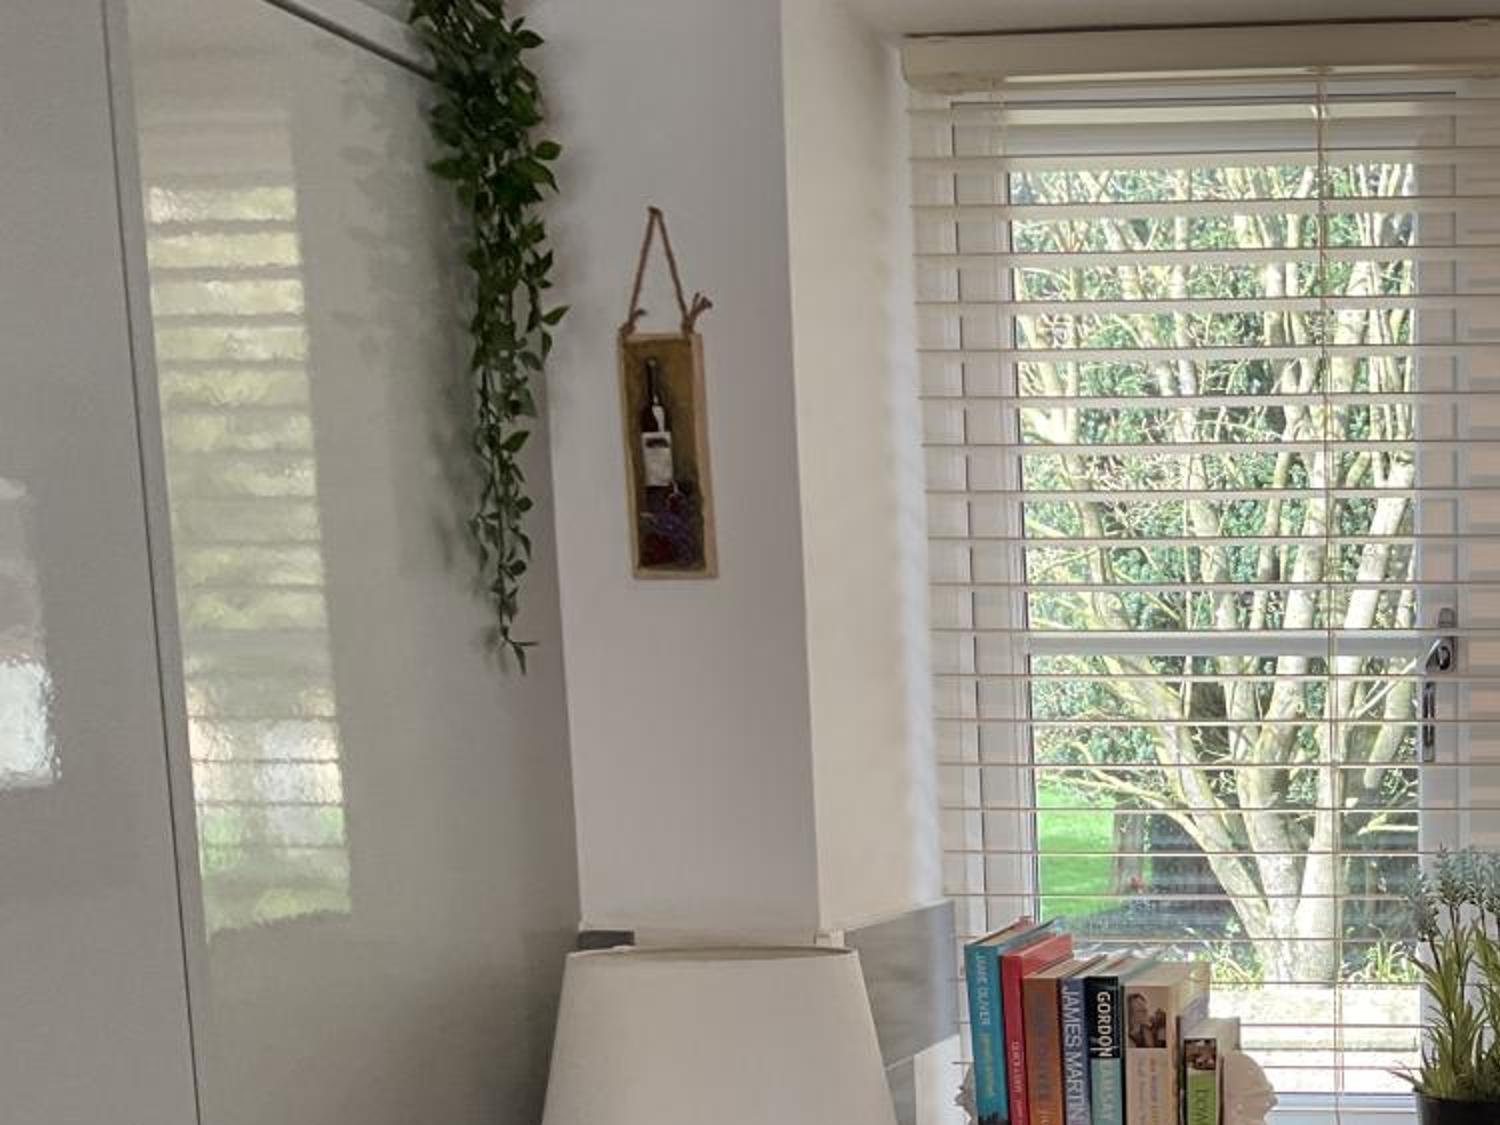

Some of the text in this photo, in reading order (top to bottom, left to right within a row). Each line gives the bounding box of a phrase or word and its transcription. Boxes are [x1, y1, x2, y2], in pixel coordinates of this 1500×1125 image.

[1061, 985, 1082, 1047] JAMES
[1096, 991, 1113, 1057] GORDON
[1065, 1051, 1086, 1121] MARTIN
